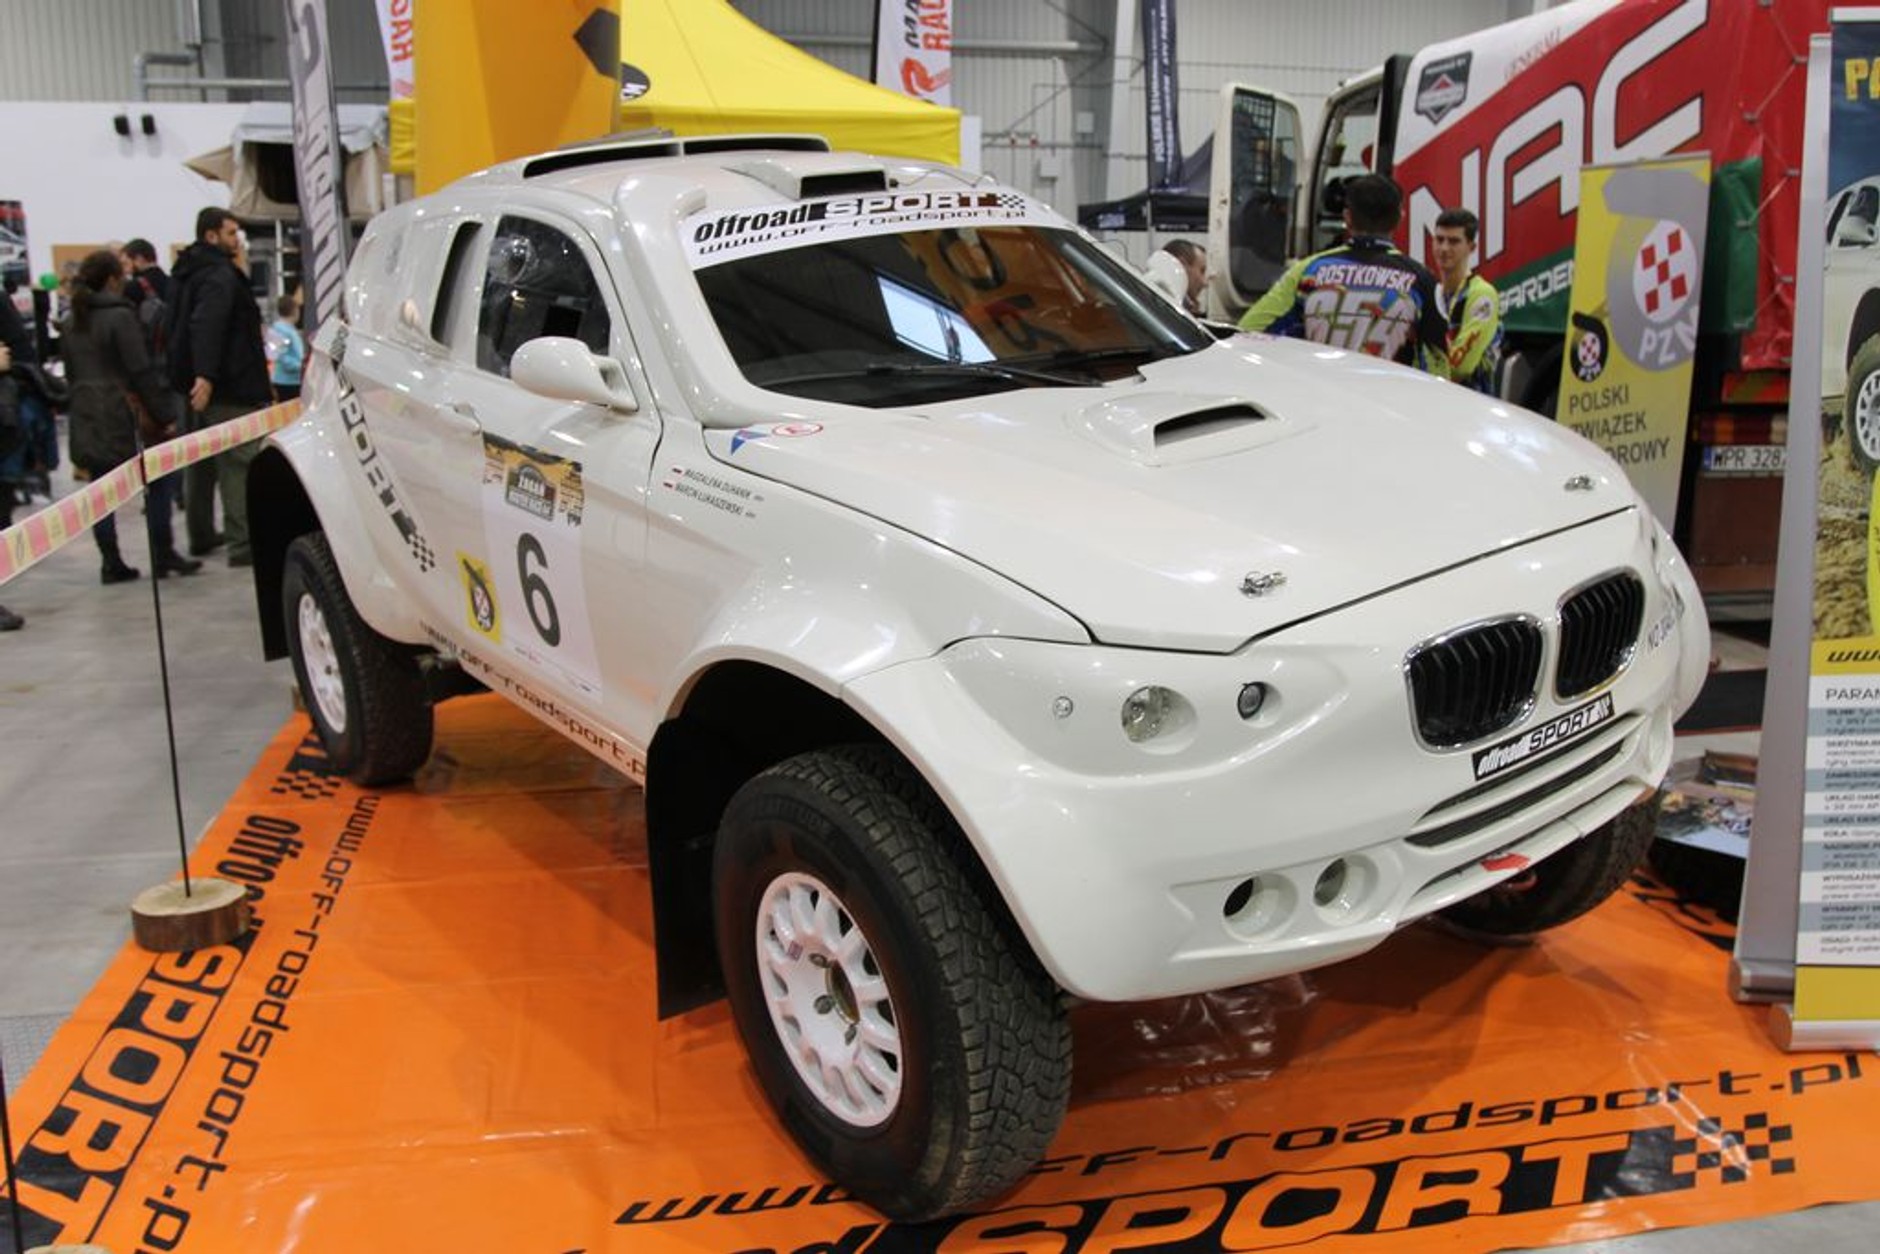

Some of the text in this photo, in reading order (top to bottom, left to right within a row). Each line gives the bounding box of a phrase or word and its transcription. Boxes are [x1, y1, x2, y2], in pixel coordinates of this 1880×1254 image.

[693, 191, 1001, 244] offroad SPORT
[1316, 264, 1418, 291] ROSTKOWSKI
[1569, 385, 1630, 414] POLSKI
[1714, 448, 1745, 467] WPR
[517, 532, 562, 648] 6
[1529, 704, 1597, 752] SPORT
